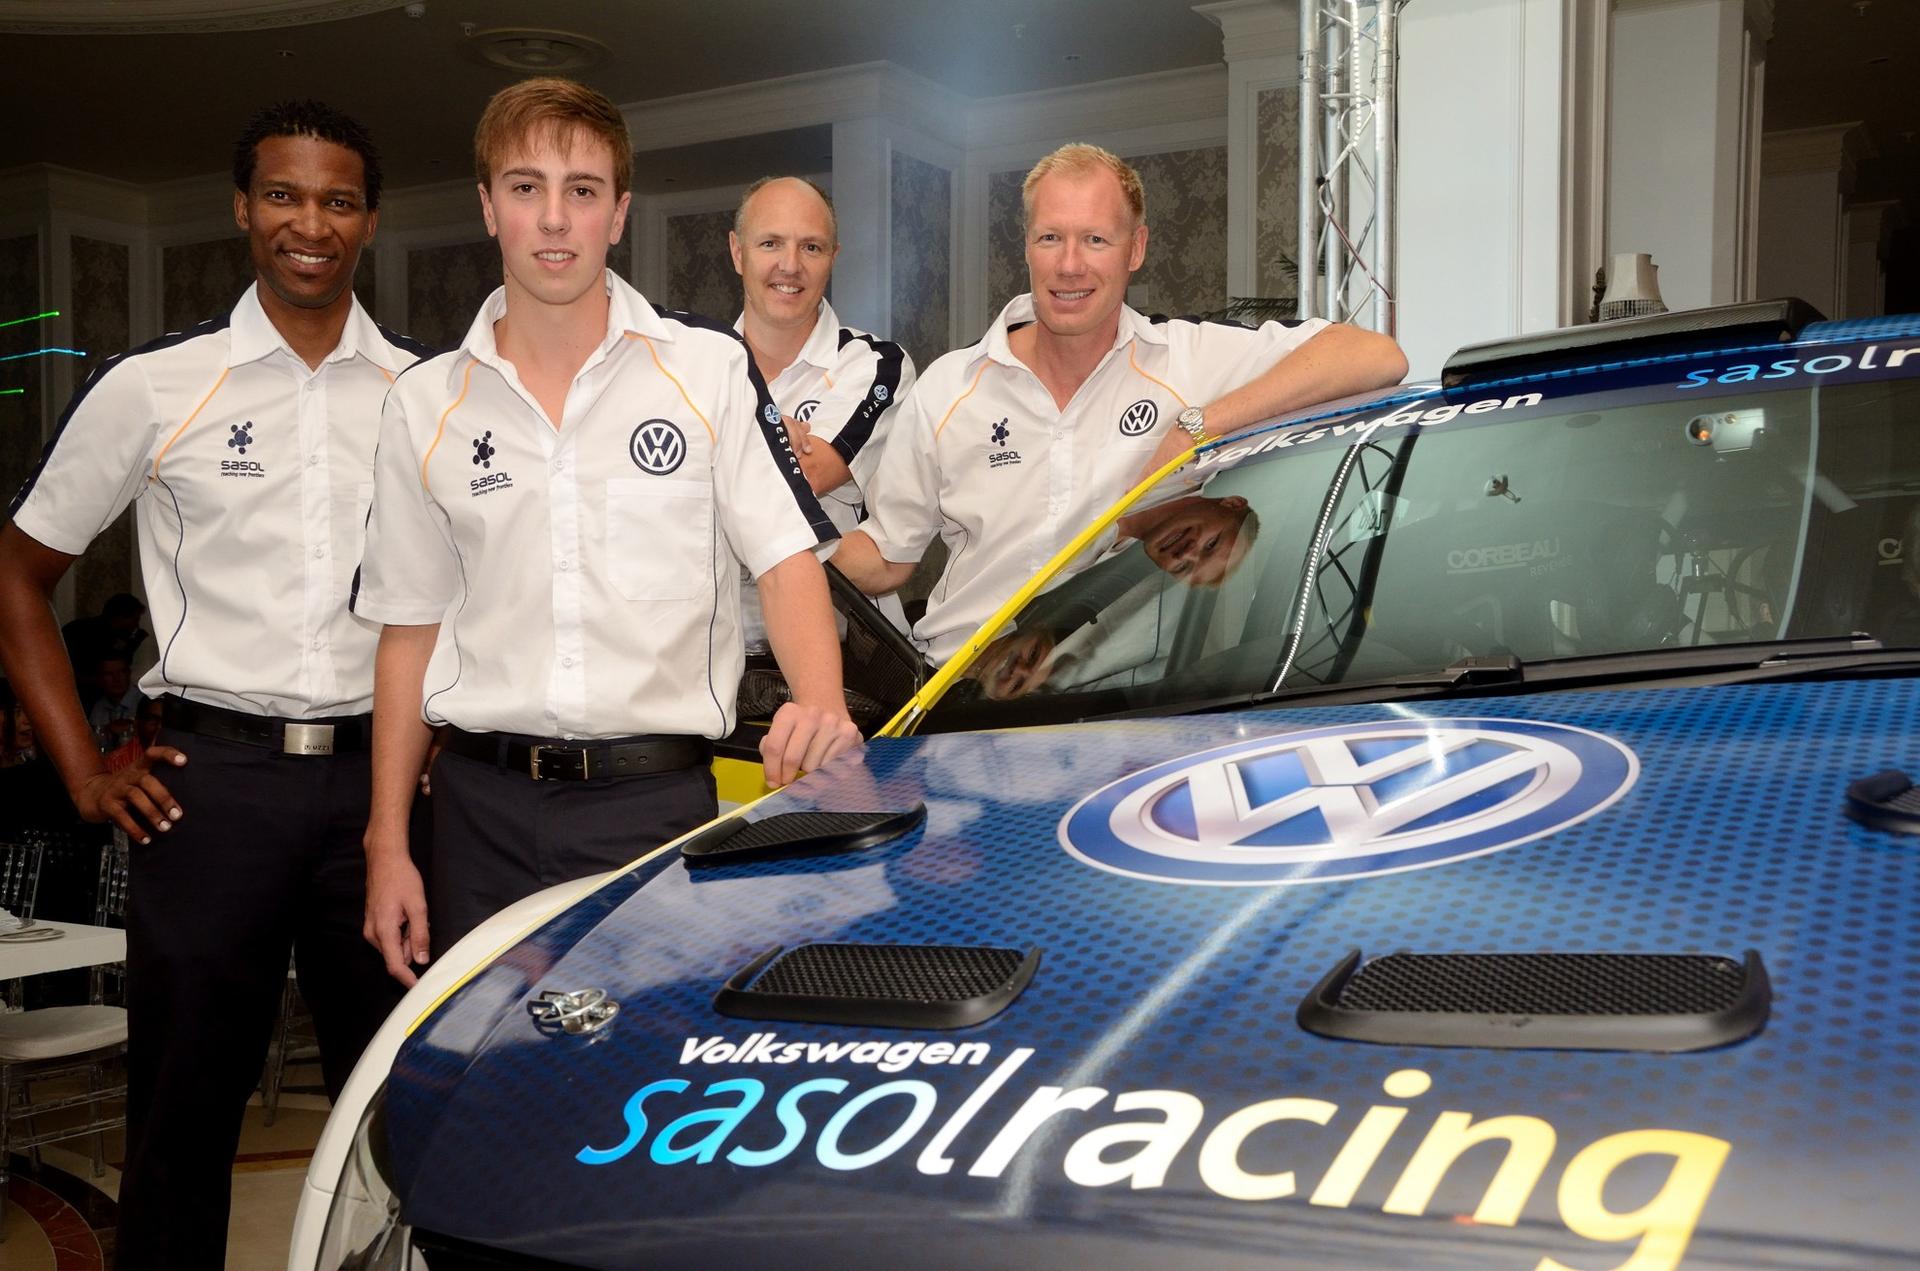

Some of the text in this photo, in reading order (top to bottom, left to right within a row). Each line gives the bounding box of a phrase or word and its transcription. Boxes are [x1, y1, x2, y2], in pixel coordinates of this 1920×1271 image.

[1194, 391, 1543, 470] Volkswagen
[1447, 537, 1560, 569] CORBEAU
[679, 1033, 990, 1073] Volkswagen
